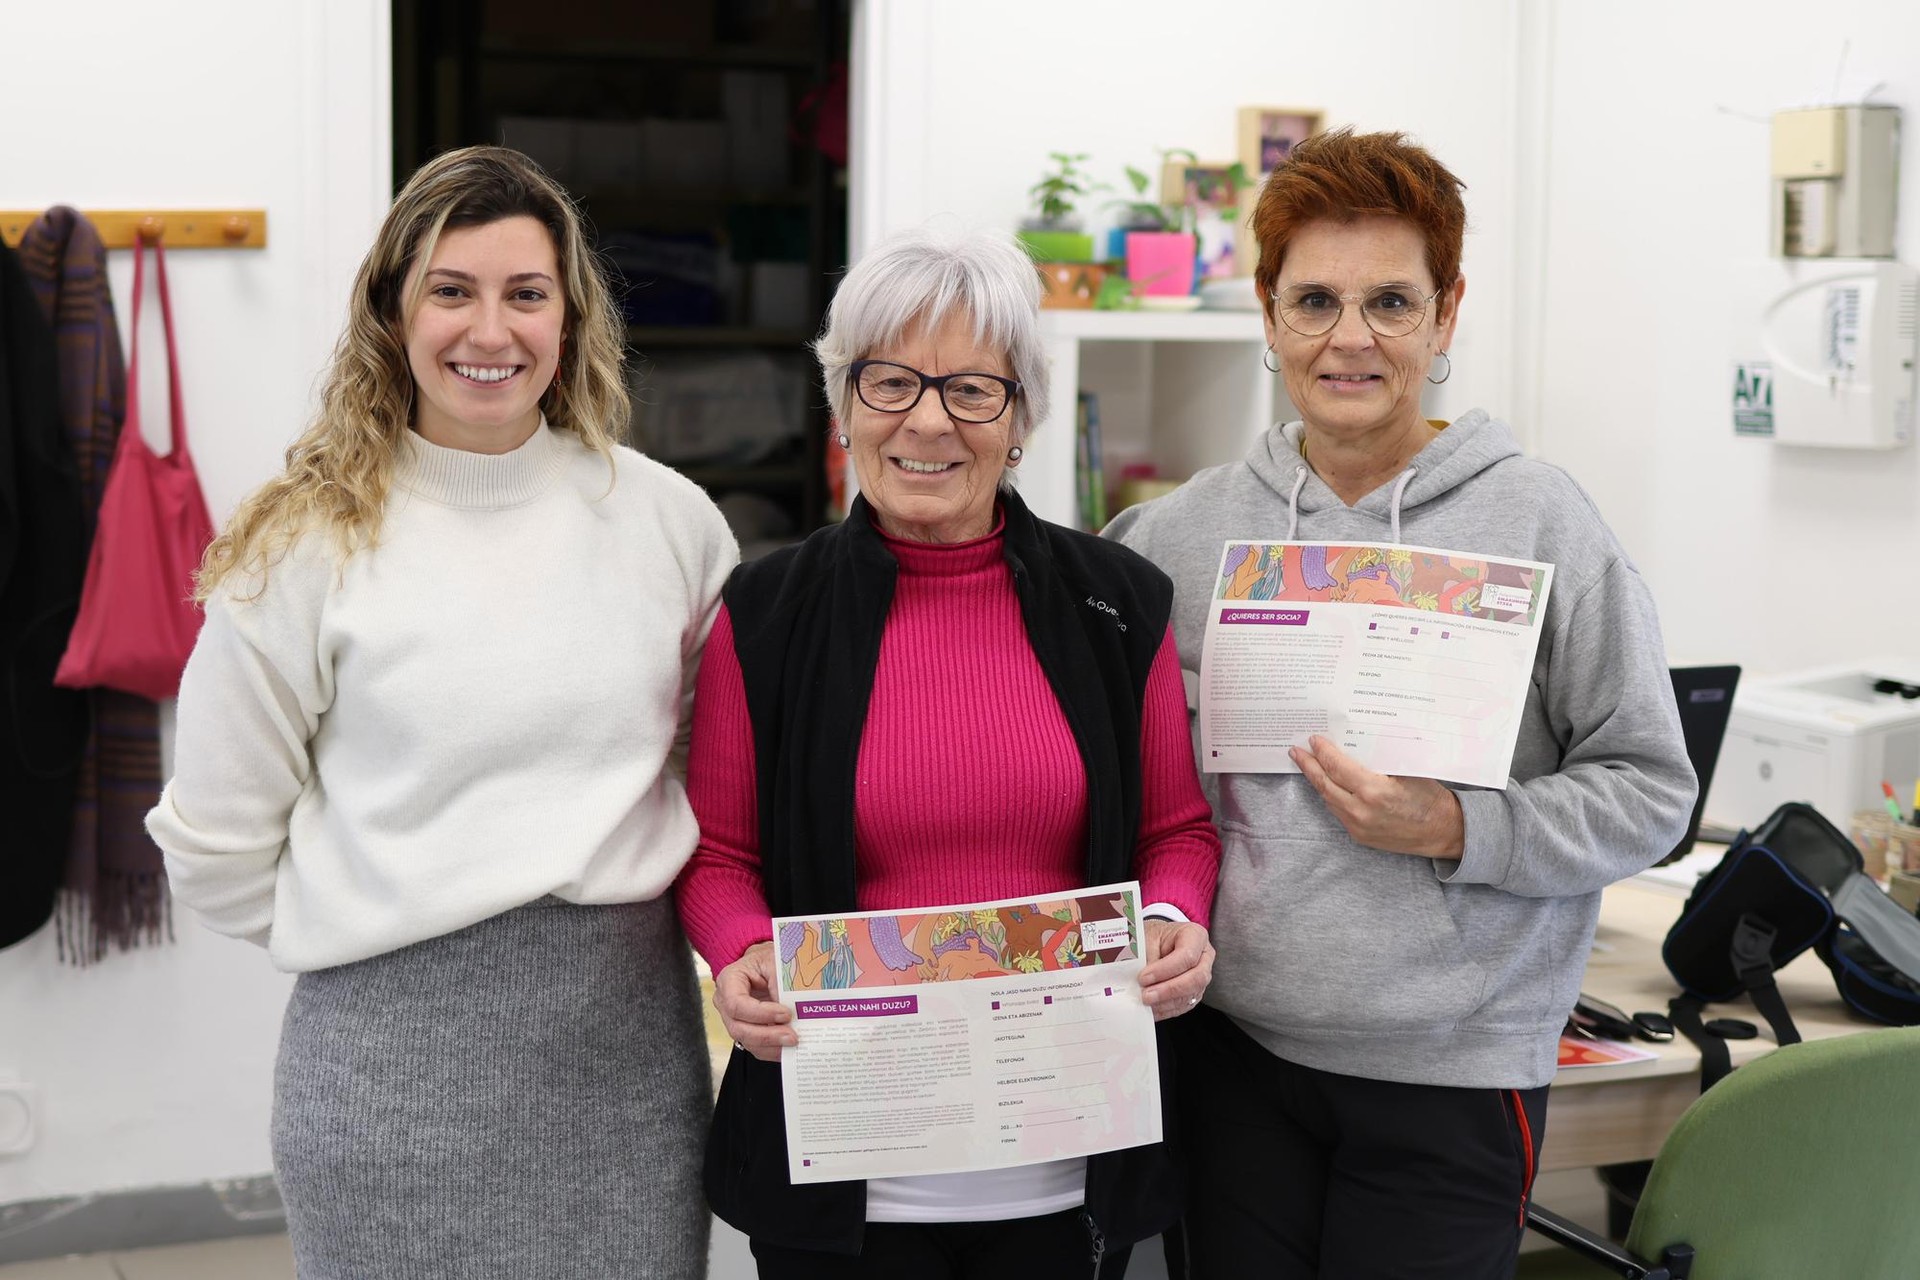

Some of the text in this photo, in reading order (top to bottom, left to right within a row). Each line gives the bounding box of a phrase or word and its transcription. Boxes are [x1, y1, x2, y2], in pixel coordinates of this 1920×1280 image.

[1227, 612, 1260, 621] ¿QUIERES
[802, 1001, 911, 1013] BAZKIDE IZAN NAHI DUZU?
